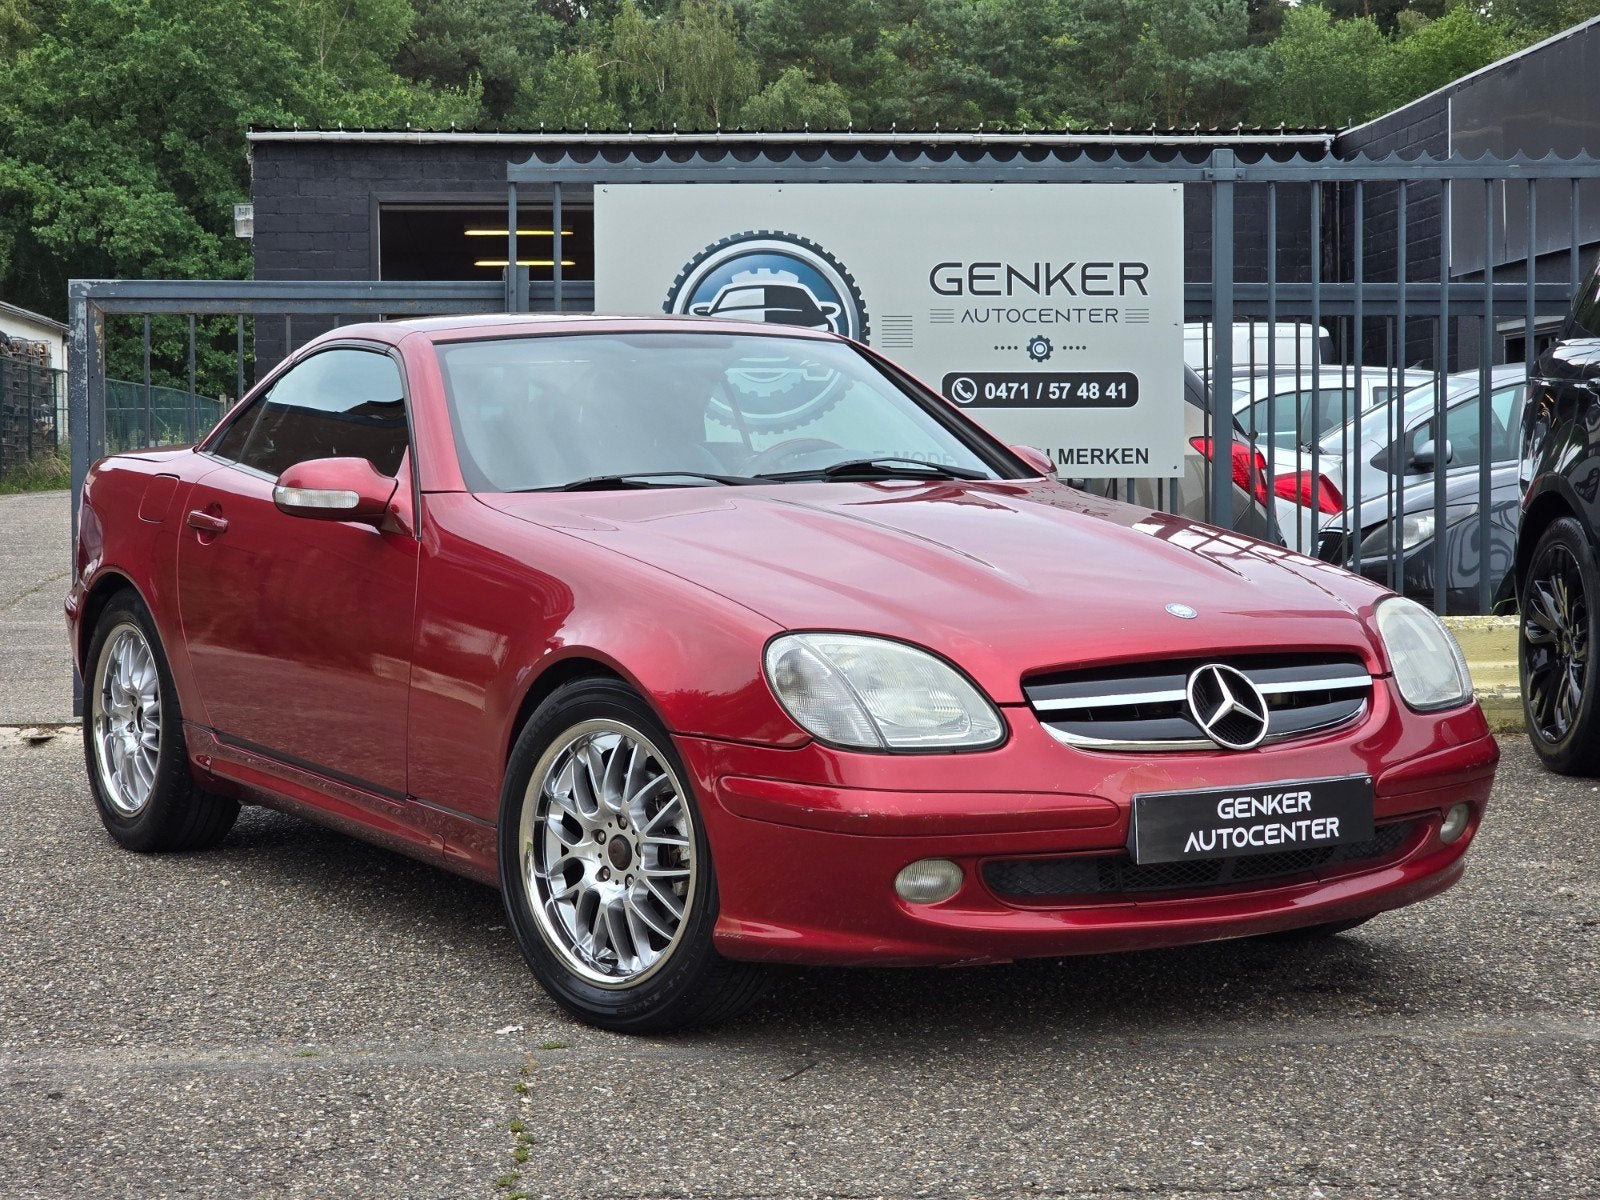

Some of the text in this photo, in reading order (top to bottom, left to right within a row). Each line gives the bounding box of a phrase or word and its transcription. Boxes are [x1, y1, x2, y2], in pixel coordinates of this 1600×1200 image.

[929, 262, 1149, 296] GENKER
[960, 308, 1119, 324] AUTOCENTER
[984, 382, 1128, 400] 0471 / 57 48 41
[1058, 447, 1149, 465] MERKEN
[1217, 791, 1311, 819] GENKER
[1184, 817, 1340, 852] AUTOCENTER
